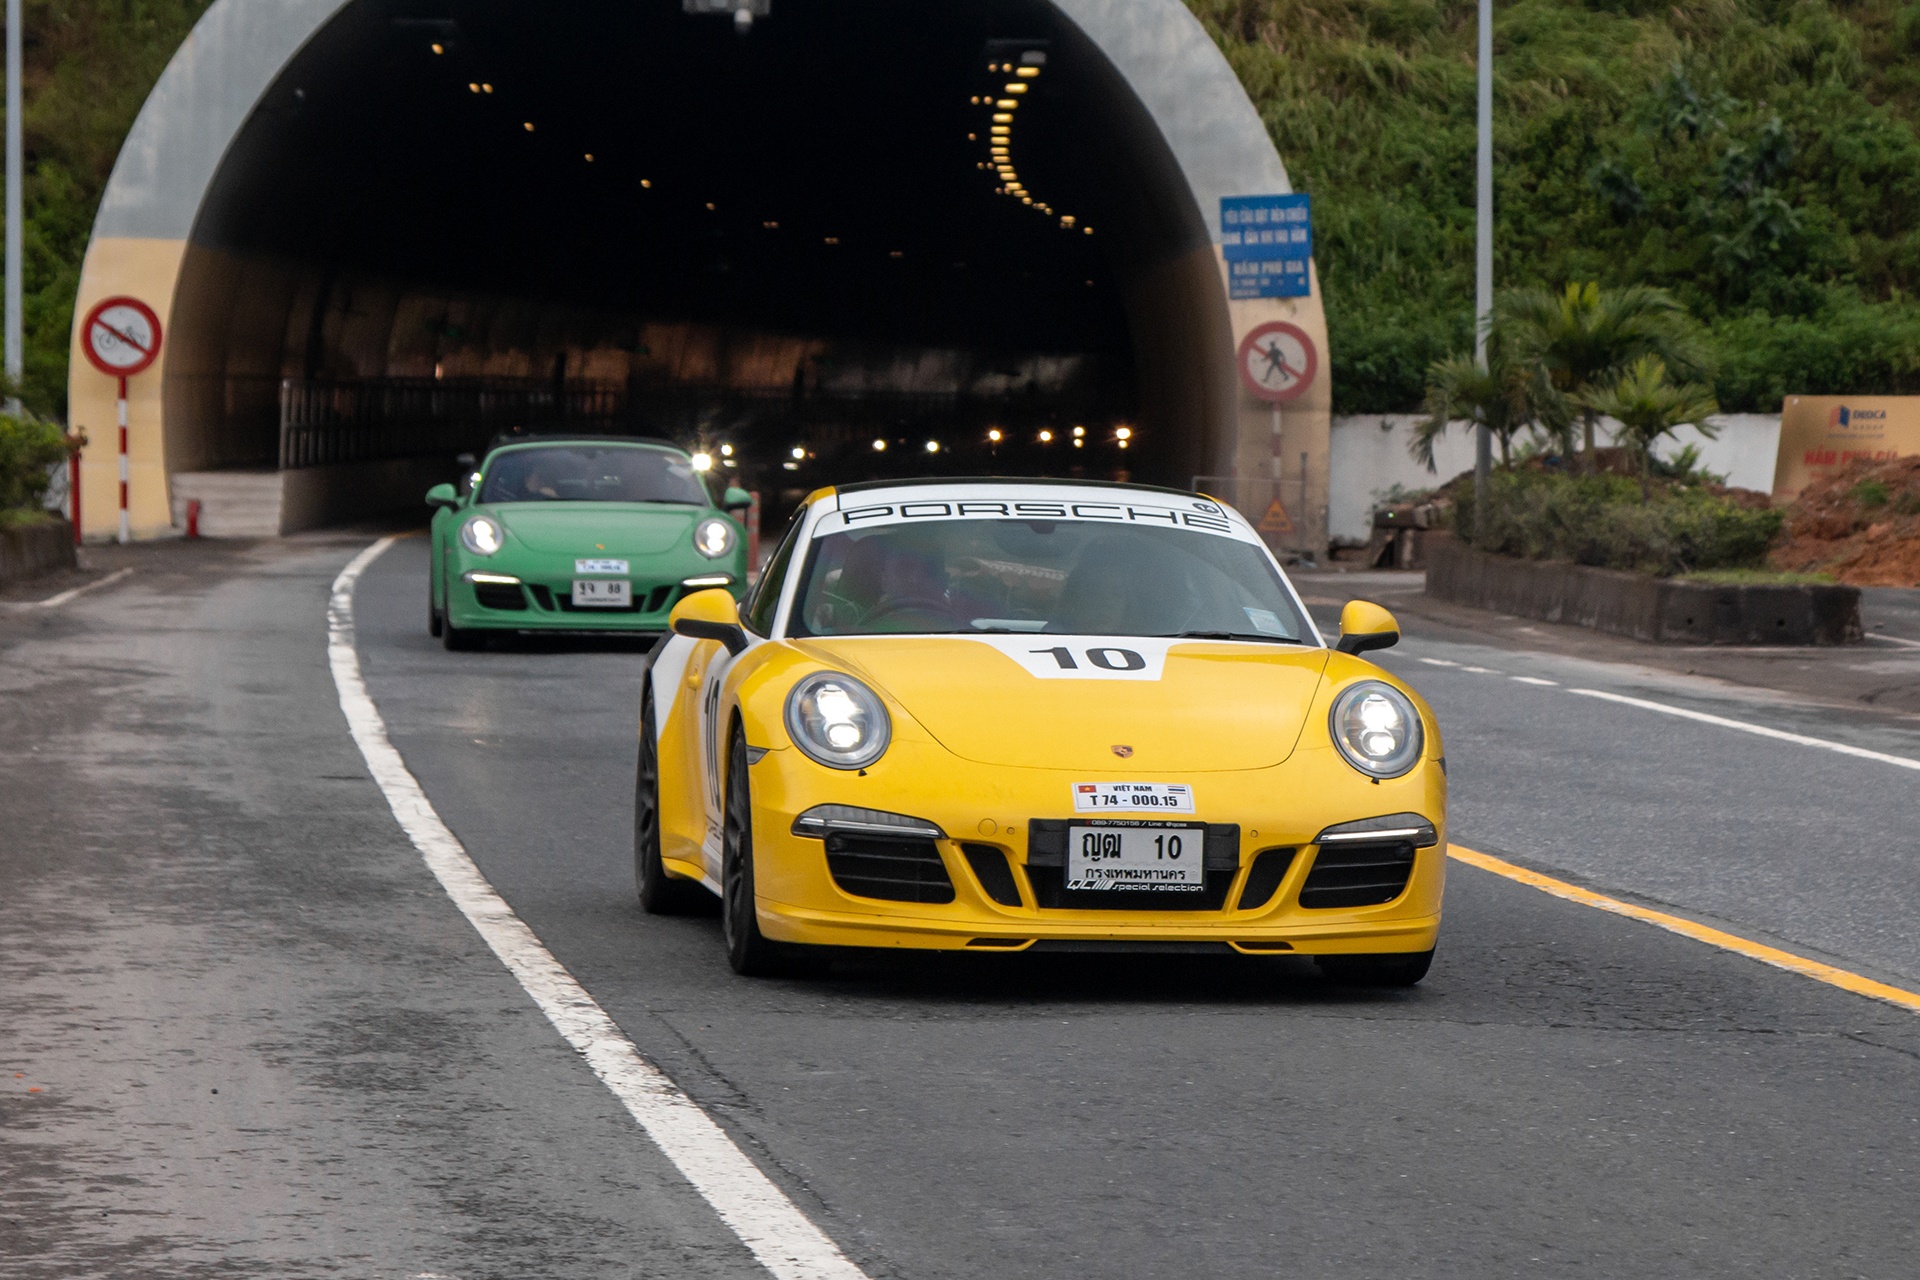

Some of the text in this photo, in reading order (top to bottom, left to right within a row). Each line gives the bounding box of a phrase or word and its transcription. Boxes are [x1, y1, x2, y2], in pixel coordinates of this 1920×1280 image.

[842, 502, 1232, 534] PORSCHE
[1028, 646, 1147, 671] 10
[1112, 785, 1131, 793] VIỆT
[1090, 795, 1098, 806] T
[1101, 794, 1119, 806] 74
[1131, 795, 1178, 807] 000.15
[1154, 834, 1182, 860] 10
[1085, 868, 1186, 880] กรงเทพมหานคร
[1112, 883, 1151, 892] special
[1152, 884, 1204, 892] selection
